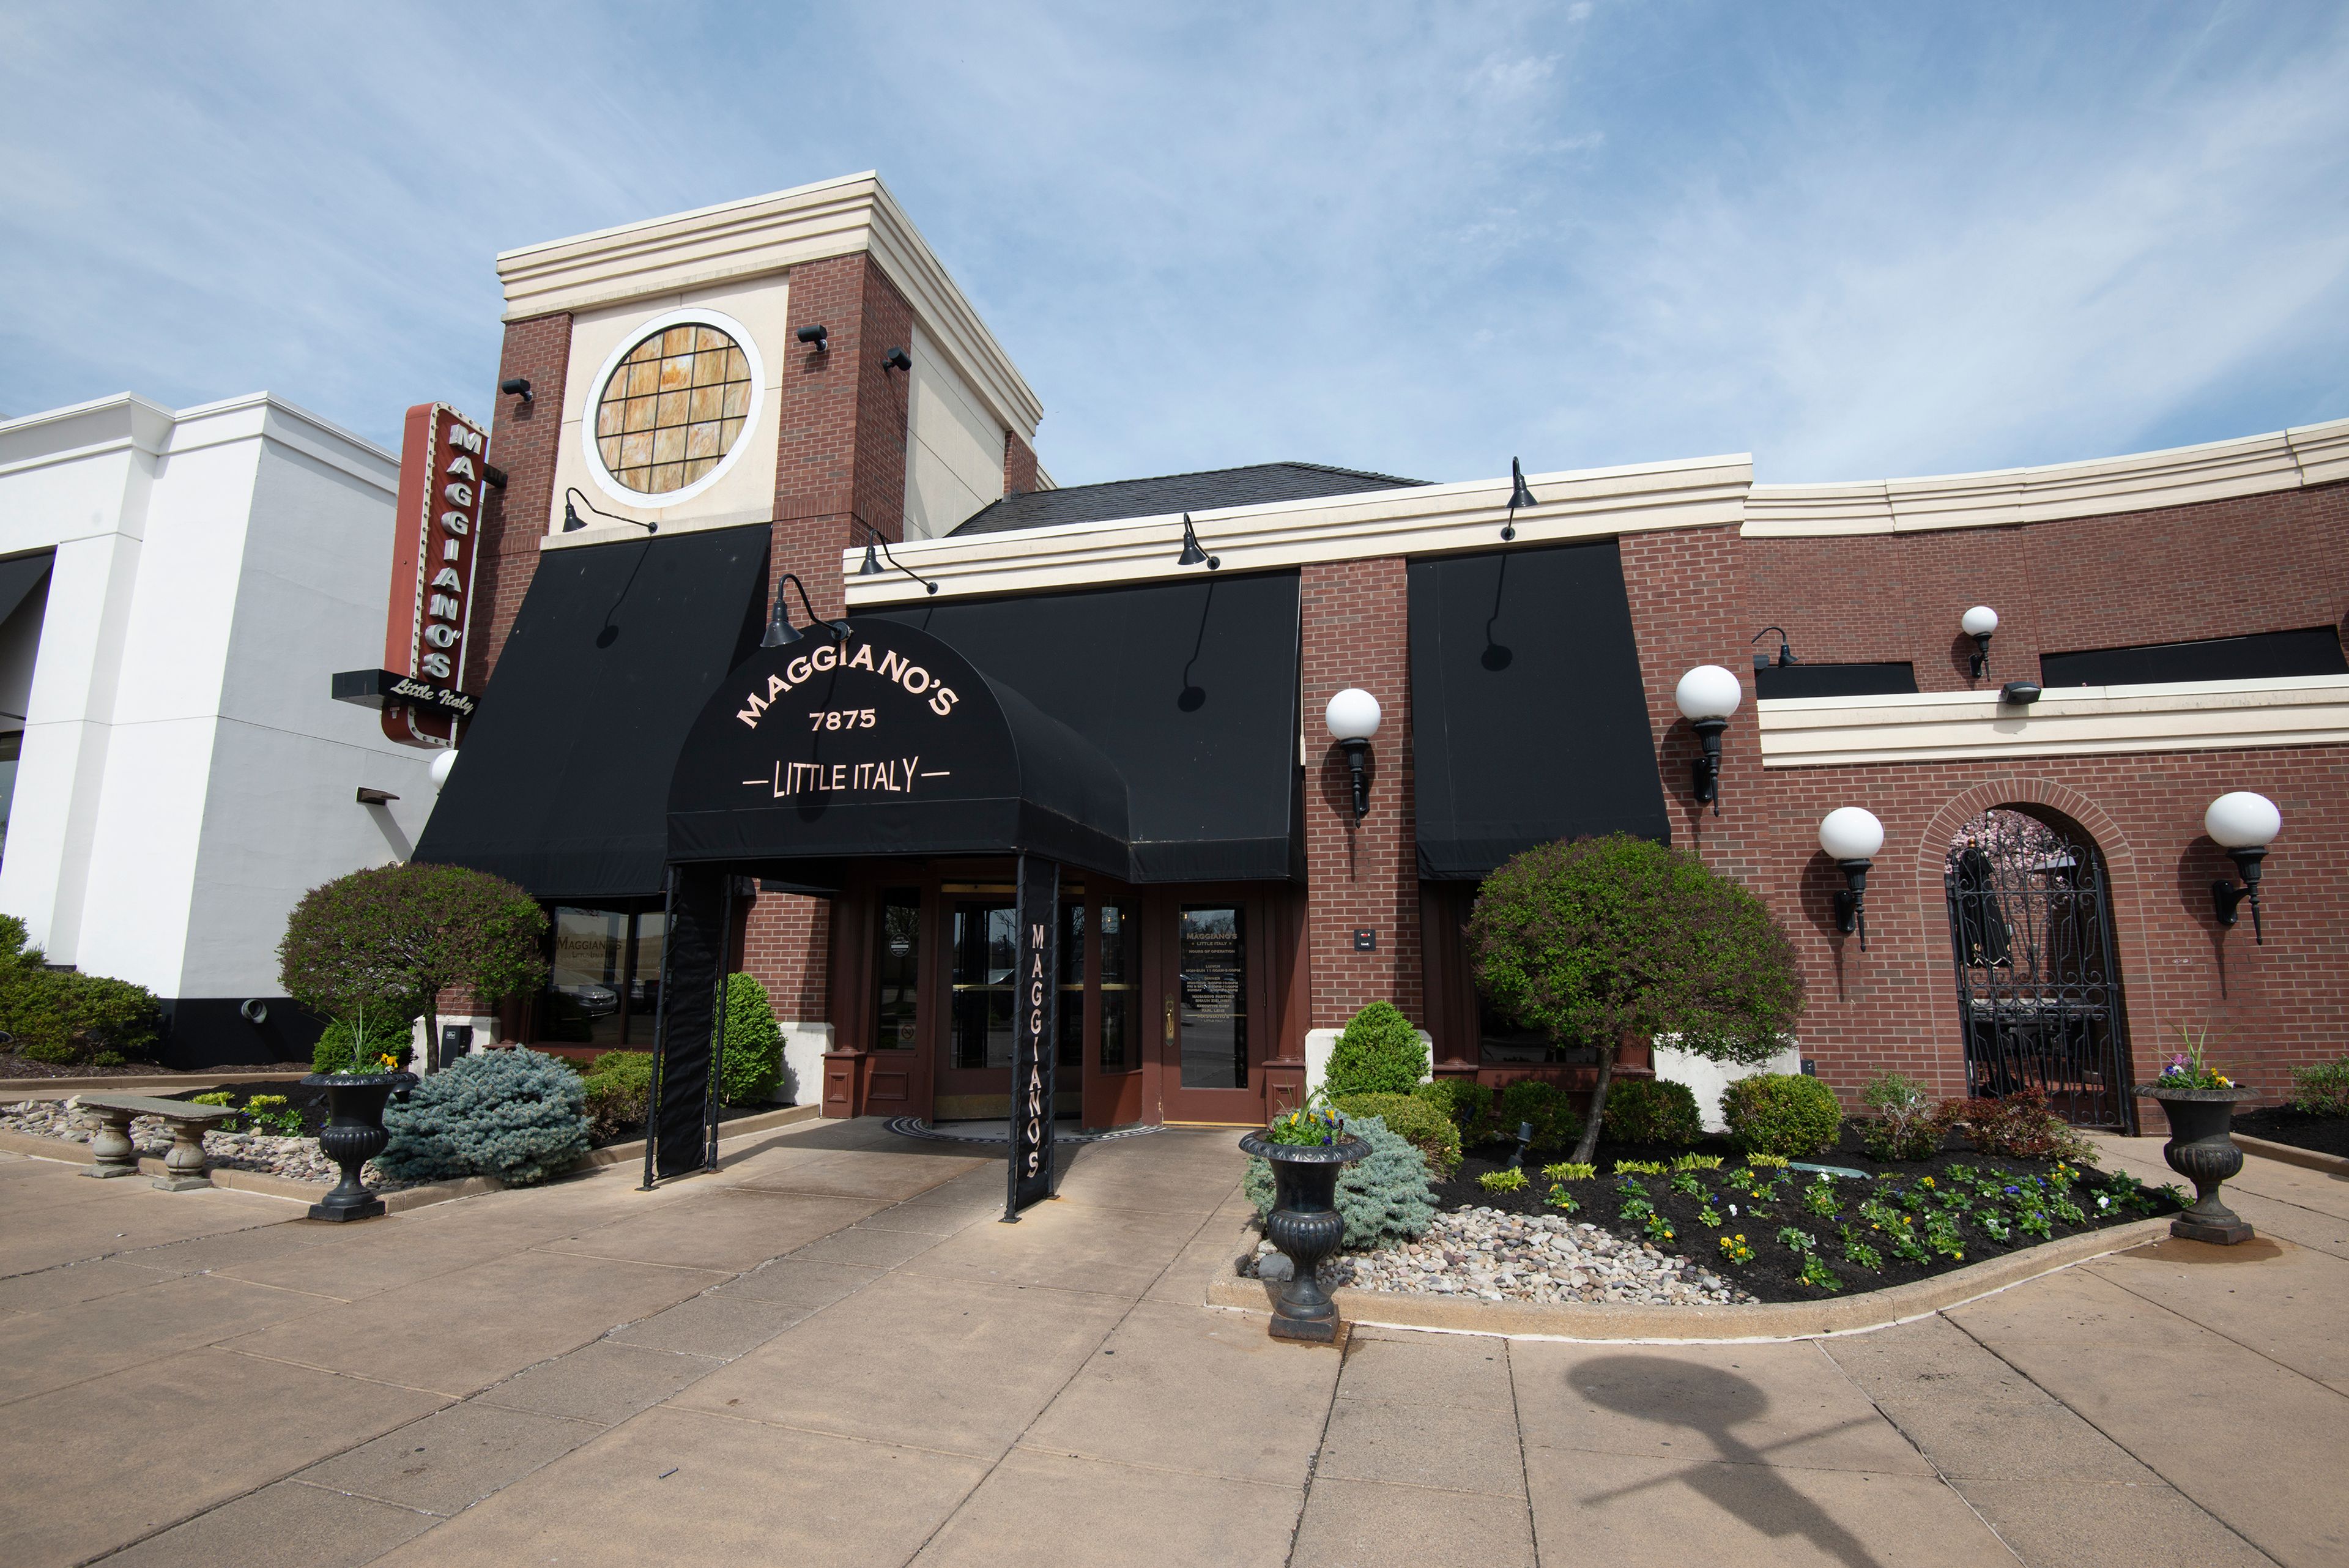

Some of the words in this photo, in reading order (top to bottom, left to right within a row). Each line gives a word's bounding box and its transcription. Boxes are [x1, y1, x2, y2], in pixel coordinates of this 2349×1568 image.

[423, 424, 481, 678] MAGGIANO'S
[390, 678, 434, 700] Little
[439, 689, 474, 716] Italy
[736, 641, 959, 729] MAGGIANO'S
[809, 708, 875, 731] 7875
[774, 760, 847, 798] LITTLE
[854, 756, 919, 793] ITALY
[557, 937, 622, 950] MAGGIANS
[1027, 924, 1044, 1178] MAGGIANO'S
